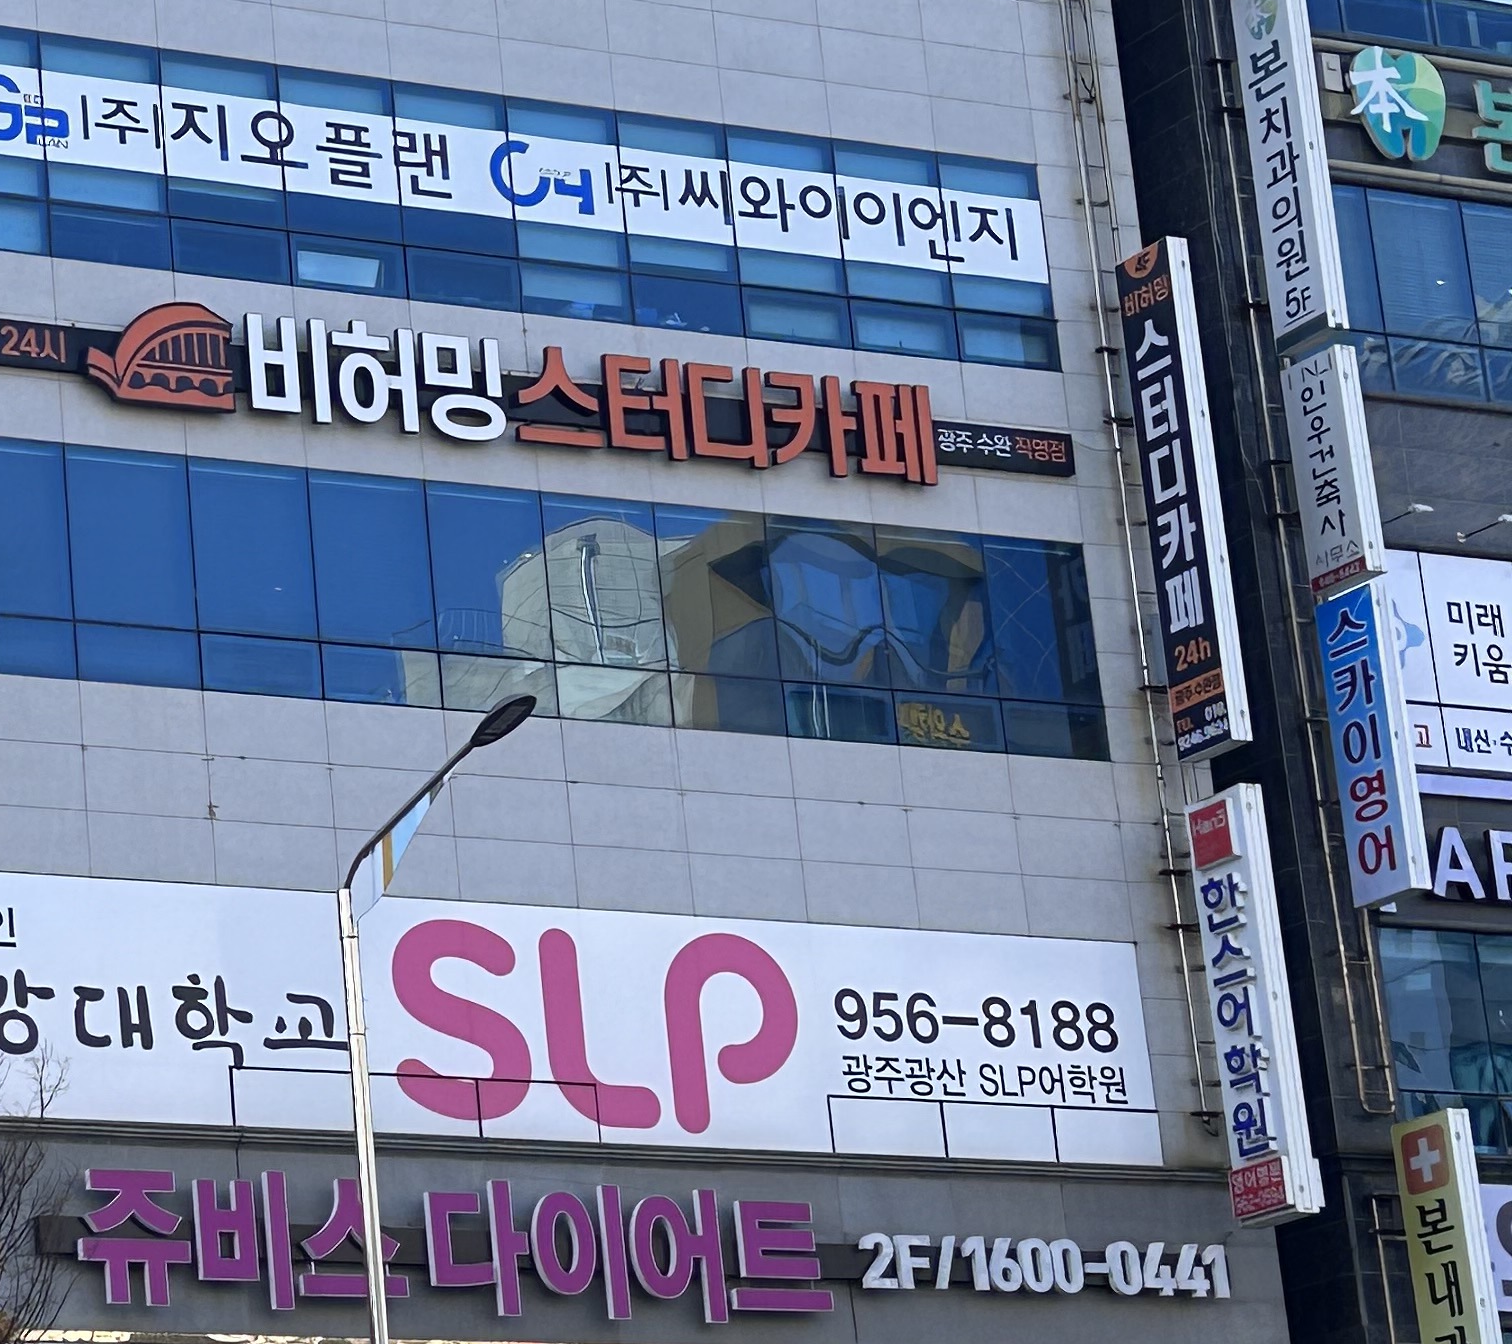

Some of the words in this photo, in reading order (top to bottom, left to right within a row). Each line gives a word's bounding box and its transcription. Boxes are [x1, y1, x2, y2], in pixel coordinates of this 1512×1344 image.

[1350, 45, 1430, 133] 本
[1248, 39, 1310, 283] 본치과의원
[1124, 275, 1170, 317] 비허밍
[1285, 286, 1312, 319] 5F
[0, 326, 67, 364] 24시
[244, 312, 508, 442] 비허밍
[515, 346, 939, 487] 스터디카페
[937, 428, 975, 453] 광주
[976, 432, 1012, 459] 수완
[1299, 360, 1346, 538] 인우건축사
[1134, 318, 1205, 635] 스터디카페
[1316, 539, 1361, 568] 사무소
[1446, 601, 1505, 639] 미래
[1174, 636, 1212, 672] 24h
[1453, 643, 1512, 685] 키움
[392, 919, 799, 1134] SLP
[834, 988, 1120, 1054] 956-8188
[1199, 872, 1272, 1159] 한스어학원
[841, 1054, 968, 1098] 광주광산
[978, 1061, 1130, 1106] SLP어학원
[78, 1169, 835, 1324] 쥬비스다이어트
[858, 1231, 1232, 1300] 2F/1600-0441
